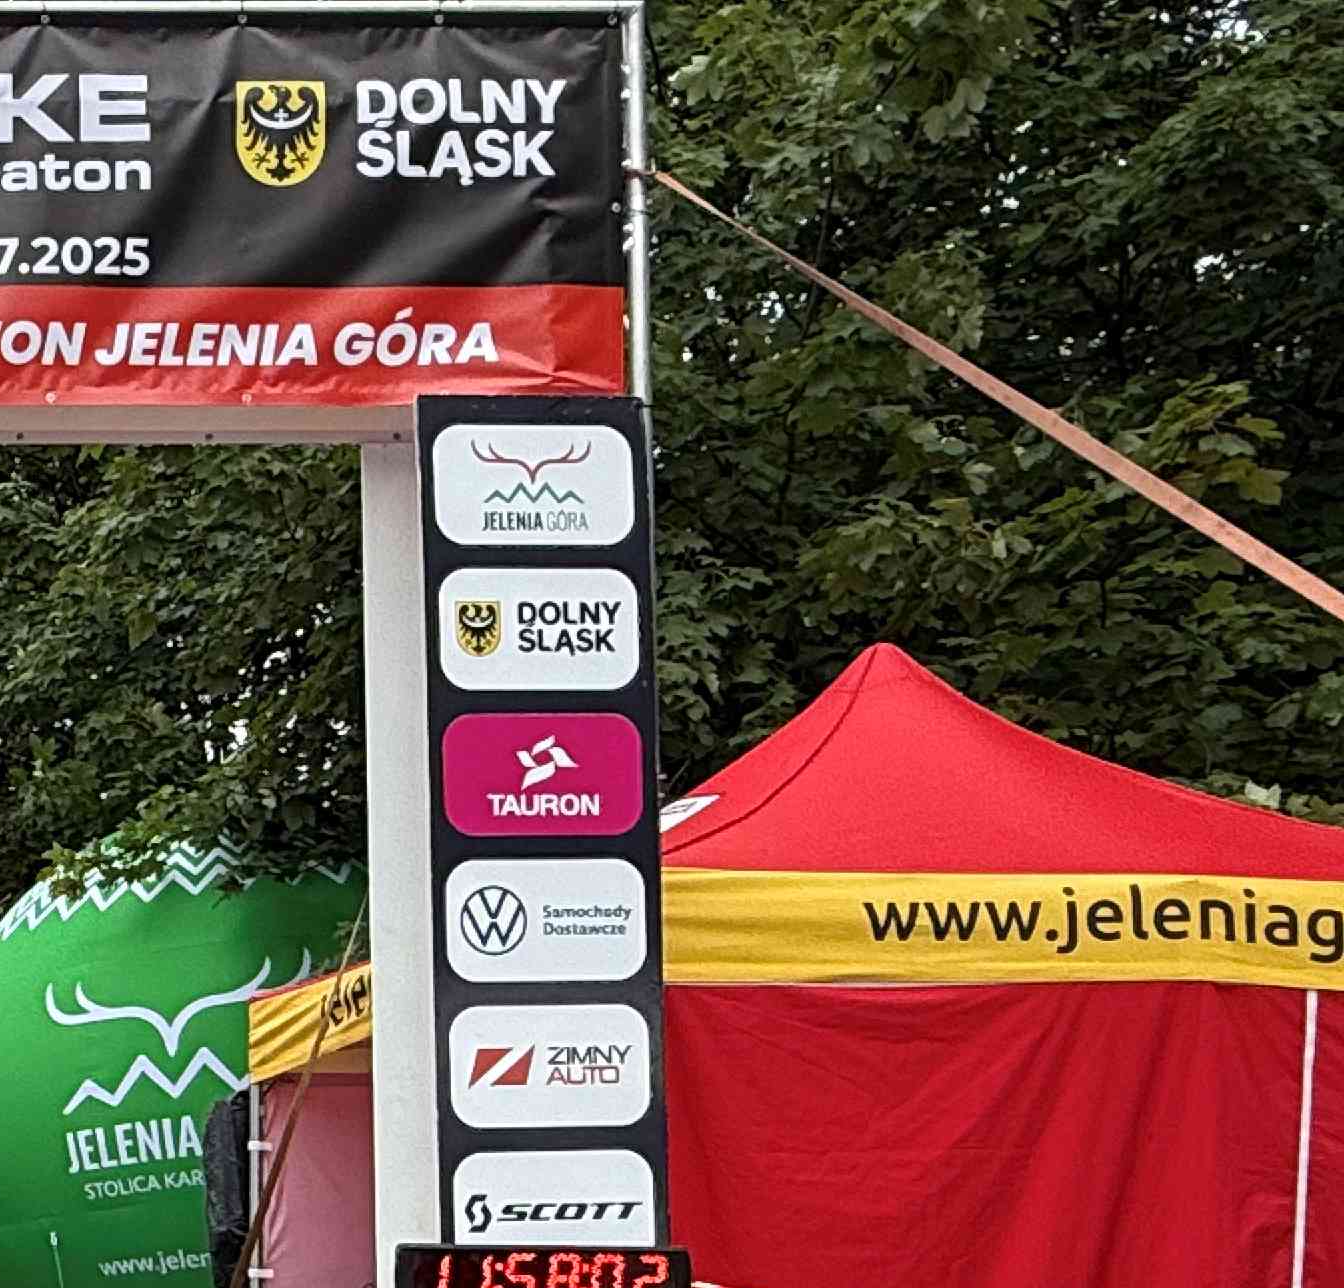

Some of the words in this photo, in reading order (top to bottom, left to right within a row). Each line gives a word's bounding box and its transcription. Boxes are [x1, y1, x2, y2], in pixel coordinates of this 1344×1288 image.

[356, 79, 567, 124] DOLNY
[356, 120, 556, 186] ŚLĄSK
[93, 321, 318, 368] JELENIA
[333, 306, 500, 366] GÓRA
[482, 510, 544, 532] JELENIA
[546, 507, 590, 531] GÓRA
[517, 601, 622, 626] DOLNY
[517, 622, 617, 656] ŚLĄSK
[485, 793, 601, 817] TAURON
[542, 904, 632, 922] Samochody
[542, 921, 627, 936] Dostawcze
[546, 1045, 632, 1065] ZIMNY
[546, 1066, 620, 1086] AUTO
[66, 1115, 204, 1174] JELENIA
[84, 1174, 162, 1200] STOLICA
[497, 1202, 643, 1222] SCOTT
